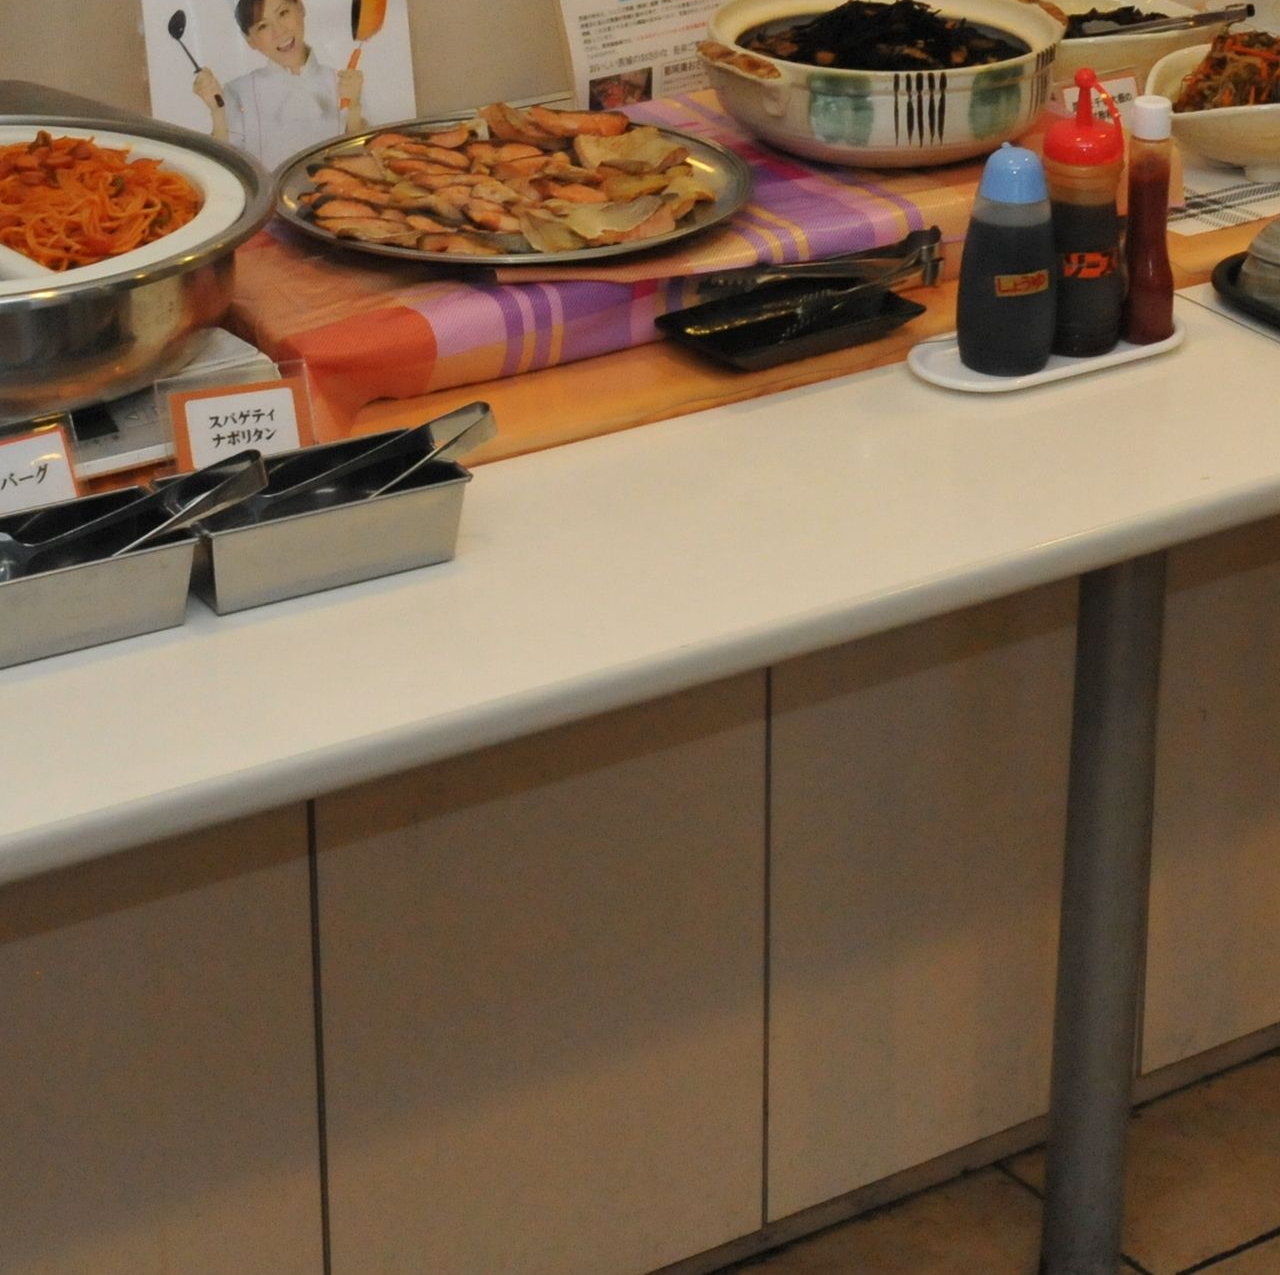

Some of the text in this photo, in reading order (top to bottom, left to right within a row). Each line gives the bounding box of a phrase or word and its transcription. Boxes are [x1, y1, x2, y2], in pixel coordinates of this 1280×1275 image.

[211, 426, 278, 449] ナポリタン
